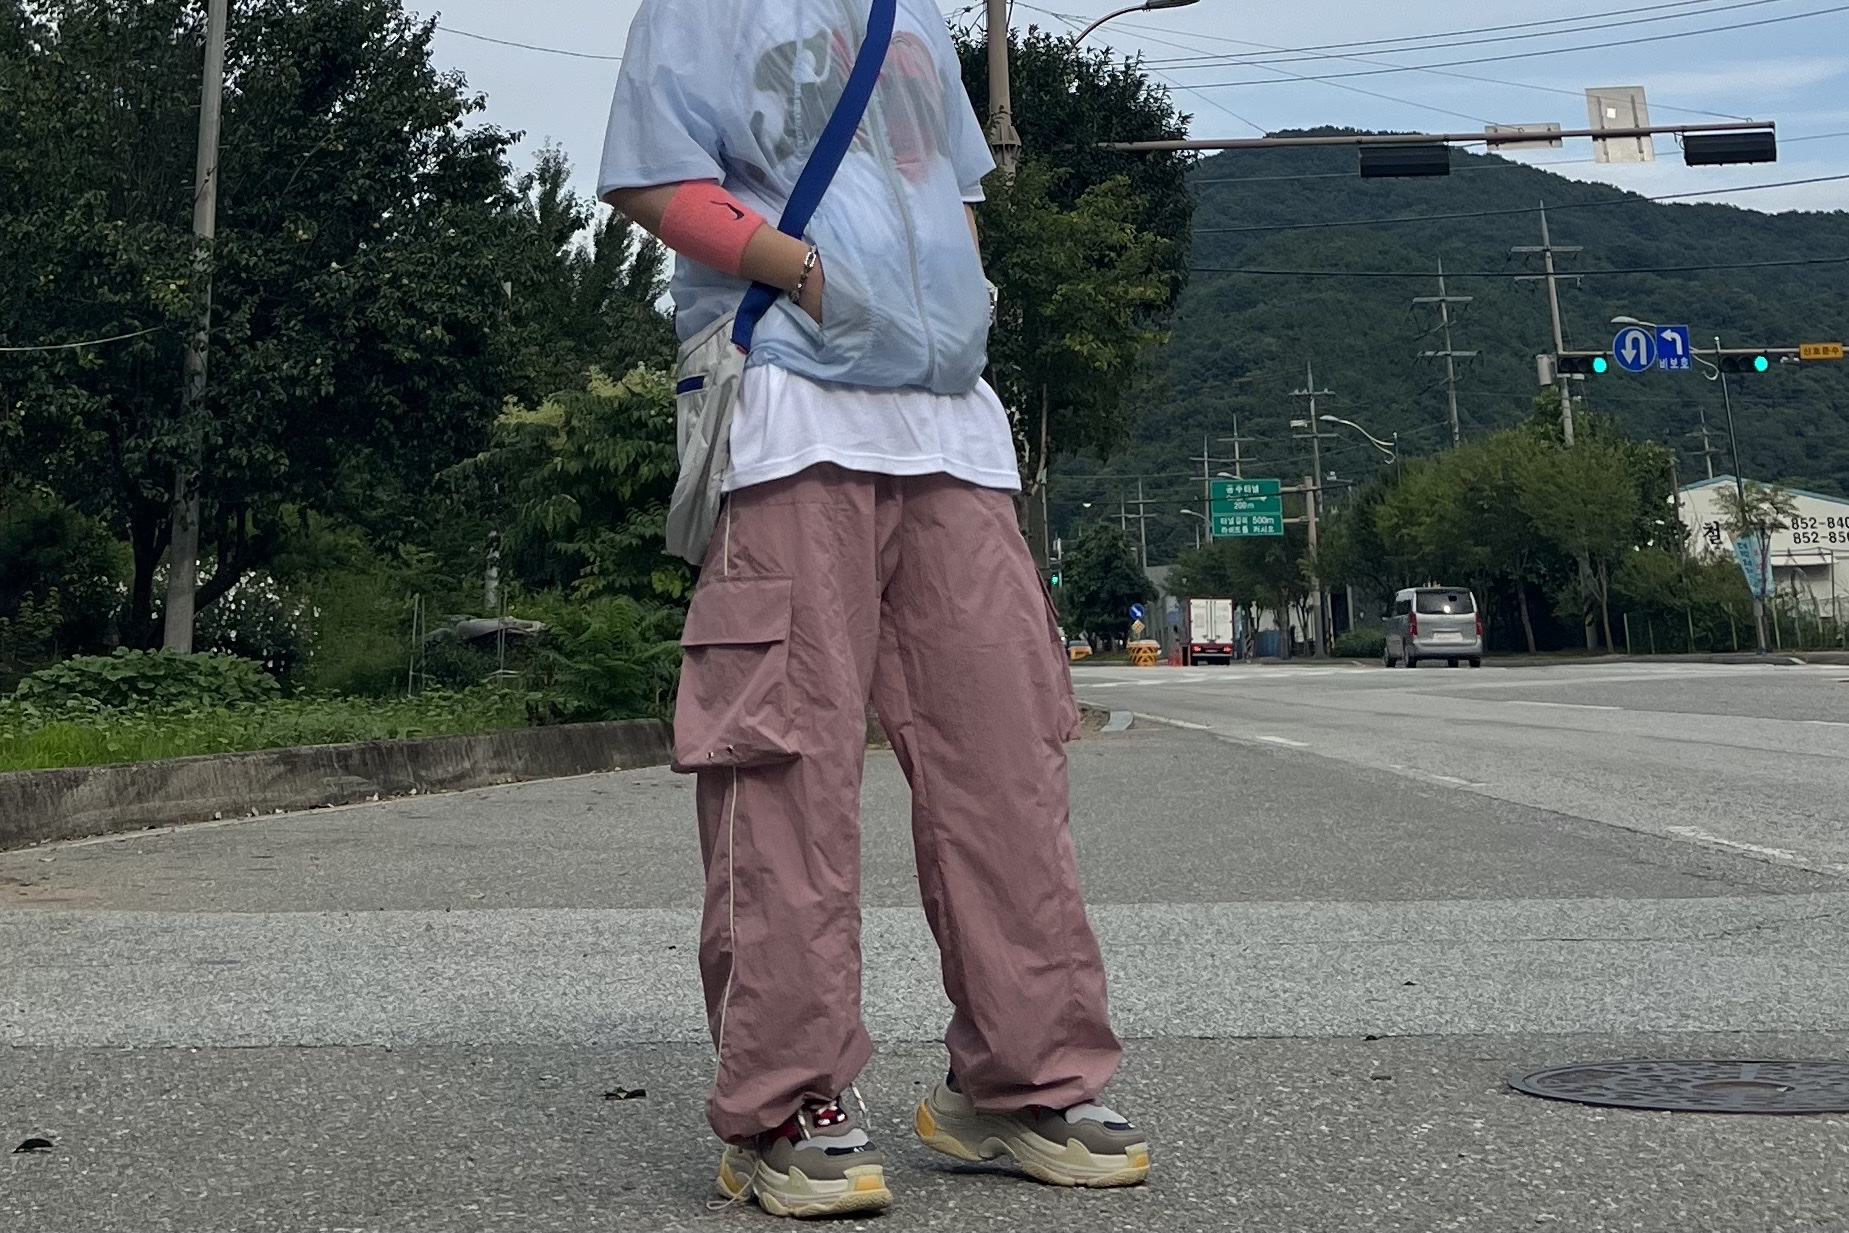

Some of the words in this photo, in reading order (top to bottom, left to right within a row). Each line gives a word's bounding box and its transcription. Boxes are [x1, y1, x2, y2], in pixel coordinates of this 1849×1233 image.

[1659, 357, 1690, 369] 비보호
[1234, 501, 1254, 509] 200m
[1252, 516, 1274, 524] 500m
